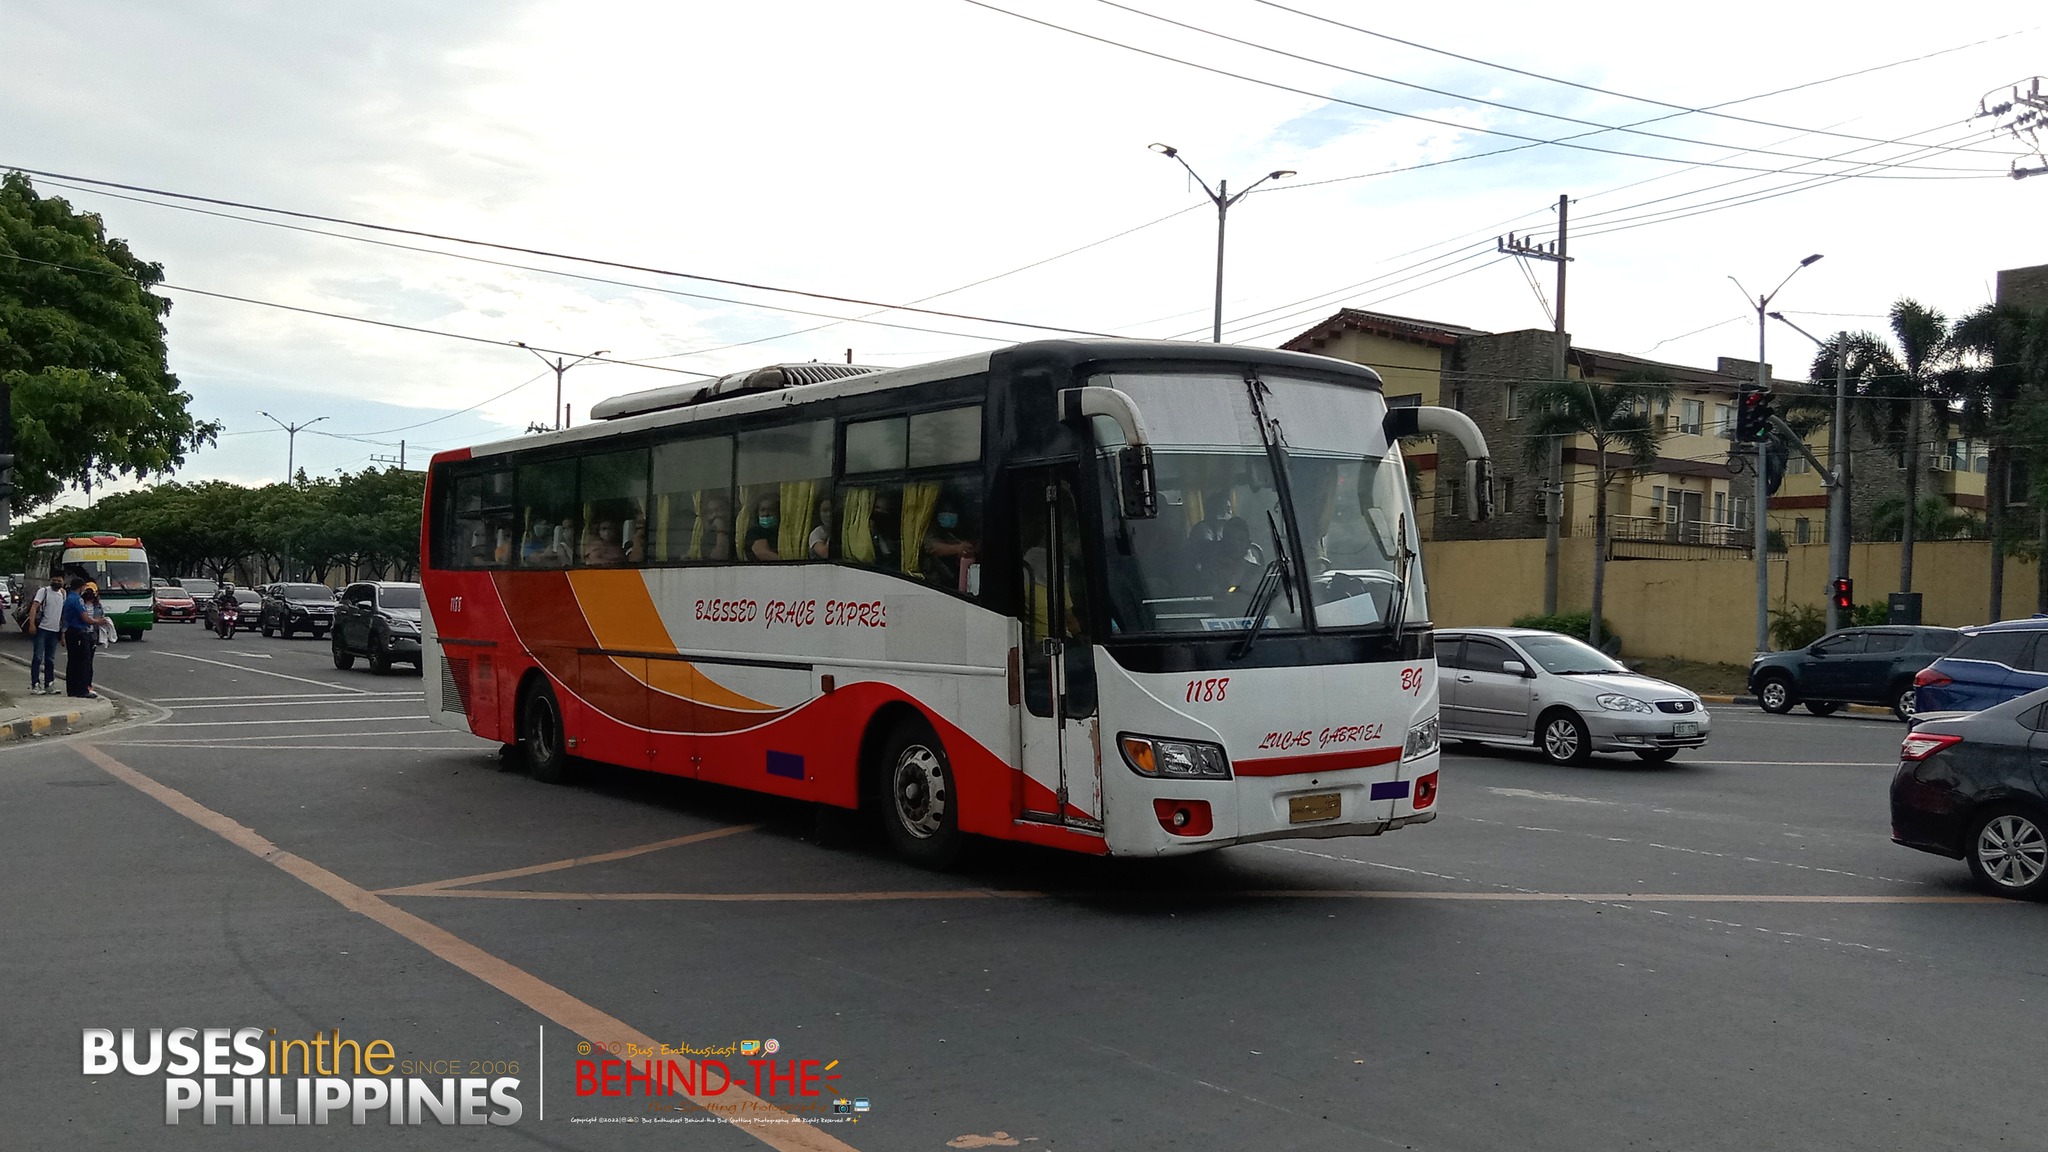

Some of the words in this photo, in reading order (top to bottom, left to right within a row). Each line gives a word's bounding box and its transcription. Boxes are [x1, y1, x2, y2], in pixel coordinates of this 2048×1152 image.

[695, 598, 758, 623] BLESSED
[765, 599, 816, 629] GRACE
[1186, 677, 1230, 703] 1188
[1401, 667, 1423, 697] BG
[1258, 730, 1312, 750] LUCAS
[1319, 723, 1383, 749] GABRIEL
